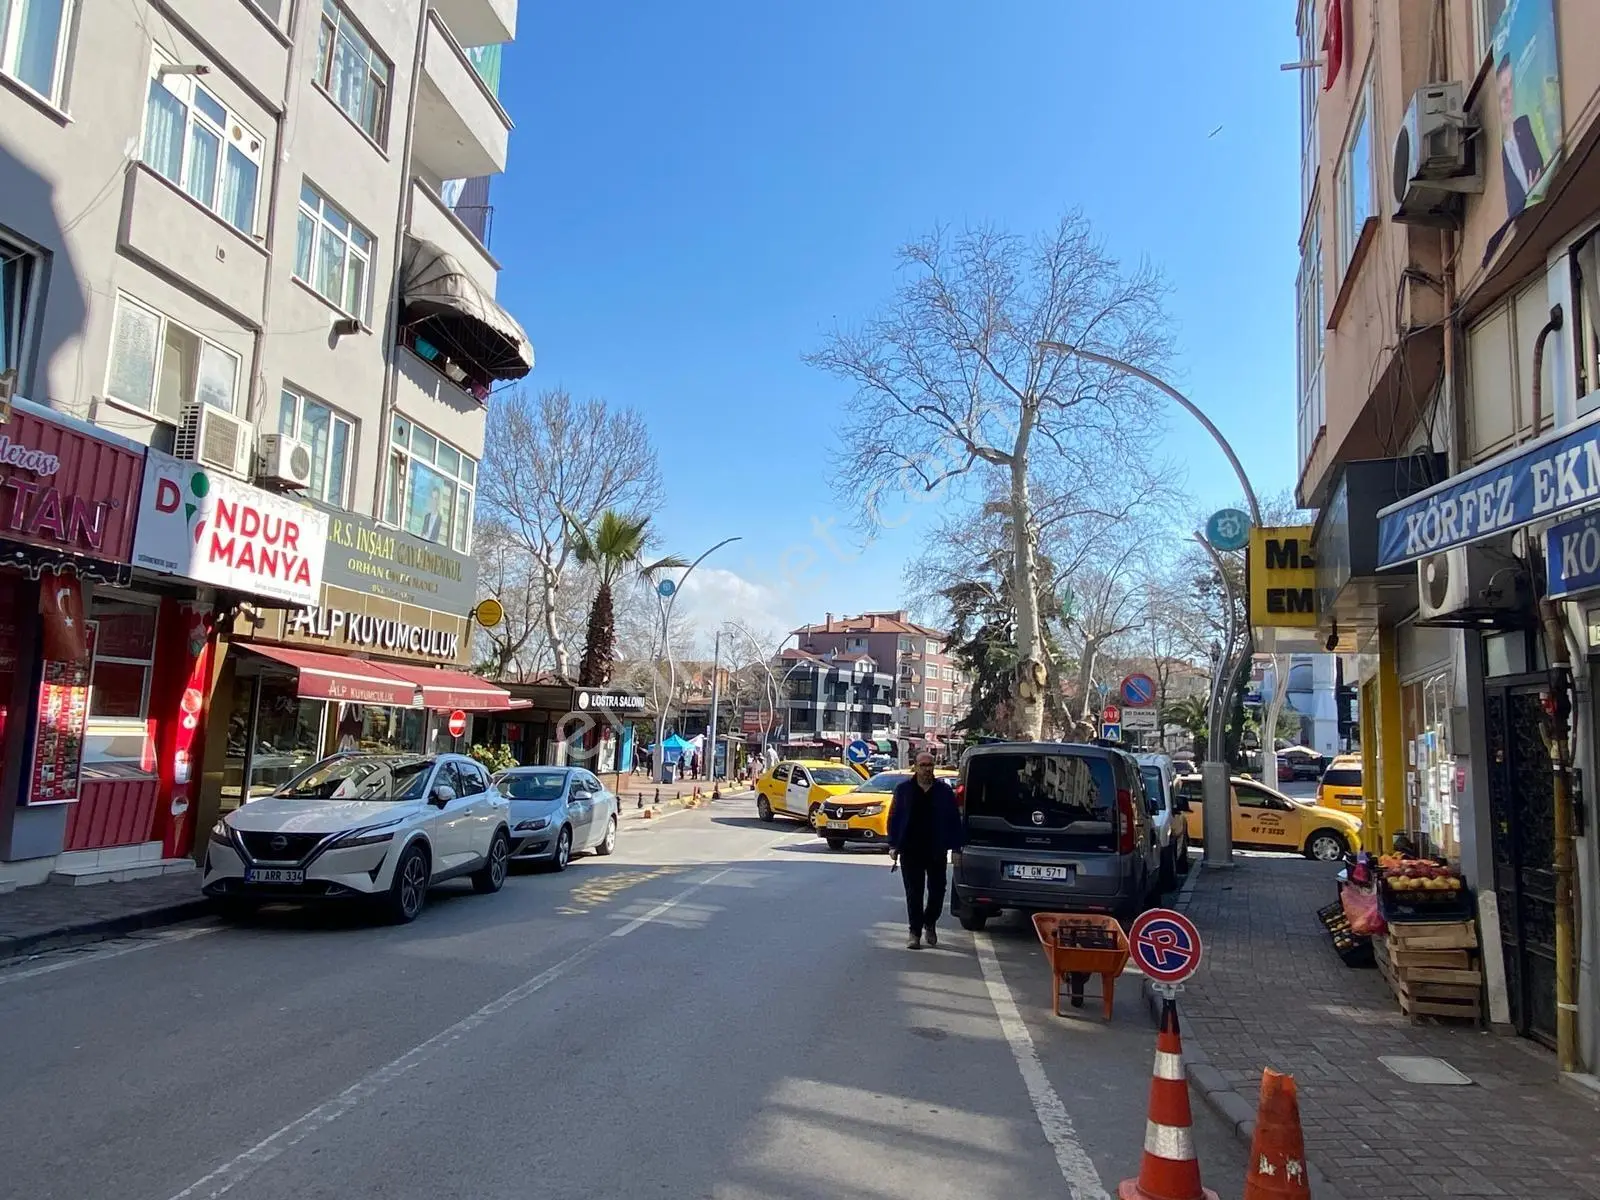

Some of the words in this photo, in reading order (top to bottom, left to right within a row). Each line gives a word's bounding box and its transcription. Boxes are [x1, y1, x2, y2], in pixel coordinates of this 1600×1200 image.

[1406, 475, 1515, 555] KÖRFEZ
[328, 519, 354, 548] .R.S.
[356, 521, 396, 561] İNŞAAT
[209, 531, 311, 587] MANYA
[347, 558, 383, 580] ORHAN
[292, 605, 344, 638] ALP
[348, 612, 459, 659] KUYUMCULUK
[350, 686, 395, 703] KUYUMCULUK
[591, 694, 618, 707] LOSTRA
[619, 695, 645, 708] SALONU
[1103, 710, 1119, 719] DUR
[250, 870, 260, 880] 41
[265, 870, 281, 881] ARR
[286, 871, 303, 881] 334
[1016, 866, 1026, 877] 41
[1046, 868, 1062, 878] 571
